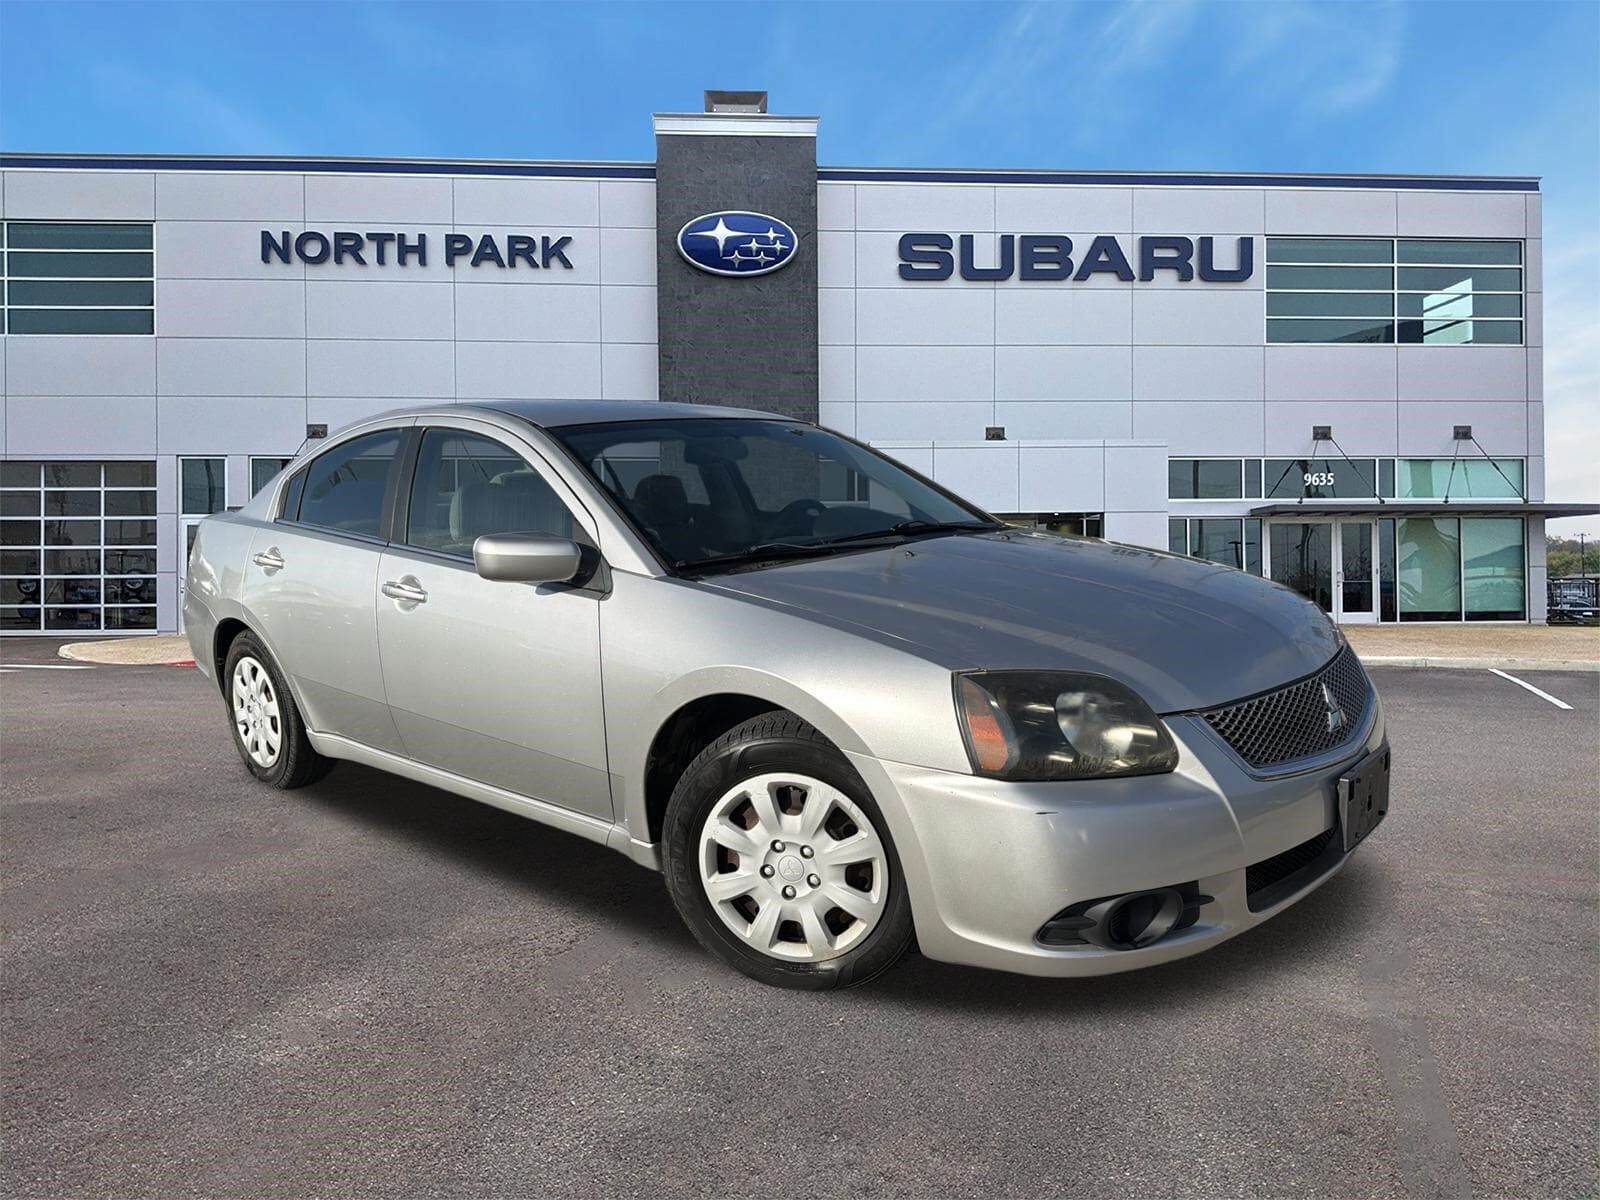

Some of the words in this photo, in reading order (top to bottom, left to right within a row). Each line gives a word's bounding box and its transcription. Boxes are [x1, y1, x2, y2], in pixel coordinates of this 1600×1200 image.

[261, 230, 427, 266] NORTH
[445, 233, 574, 269] PARK
[898, 233, 1254, 282] SUBARU
[1303, 472, 1335, 486] 9635
